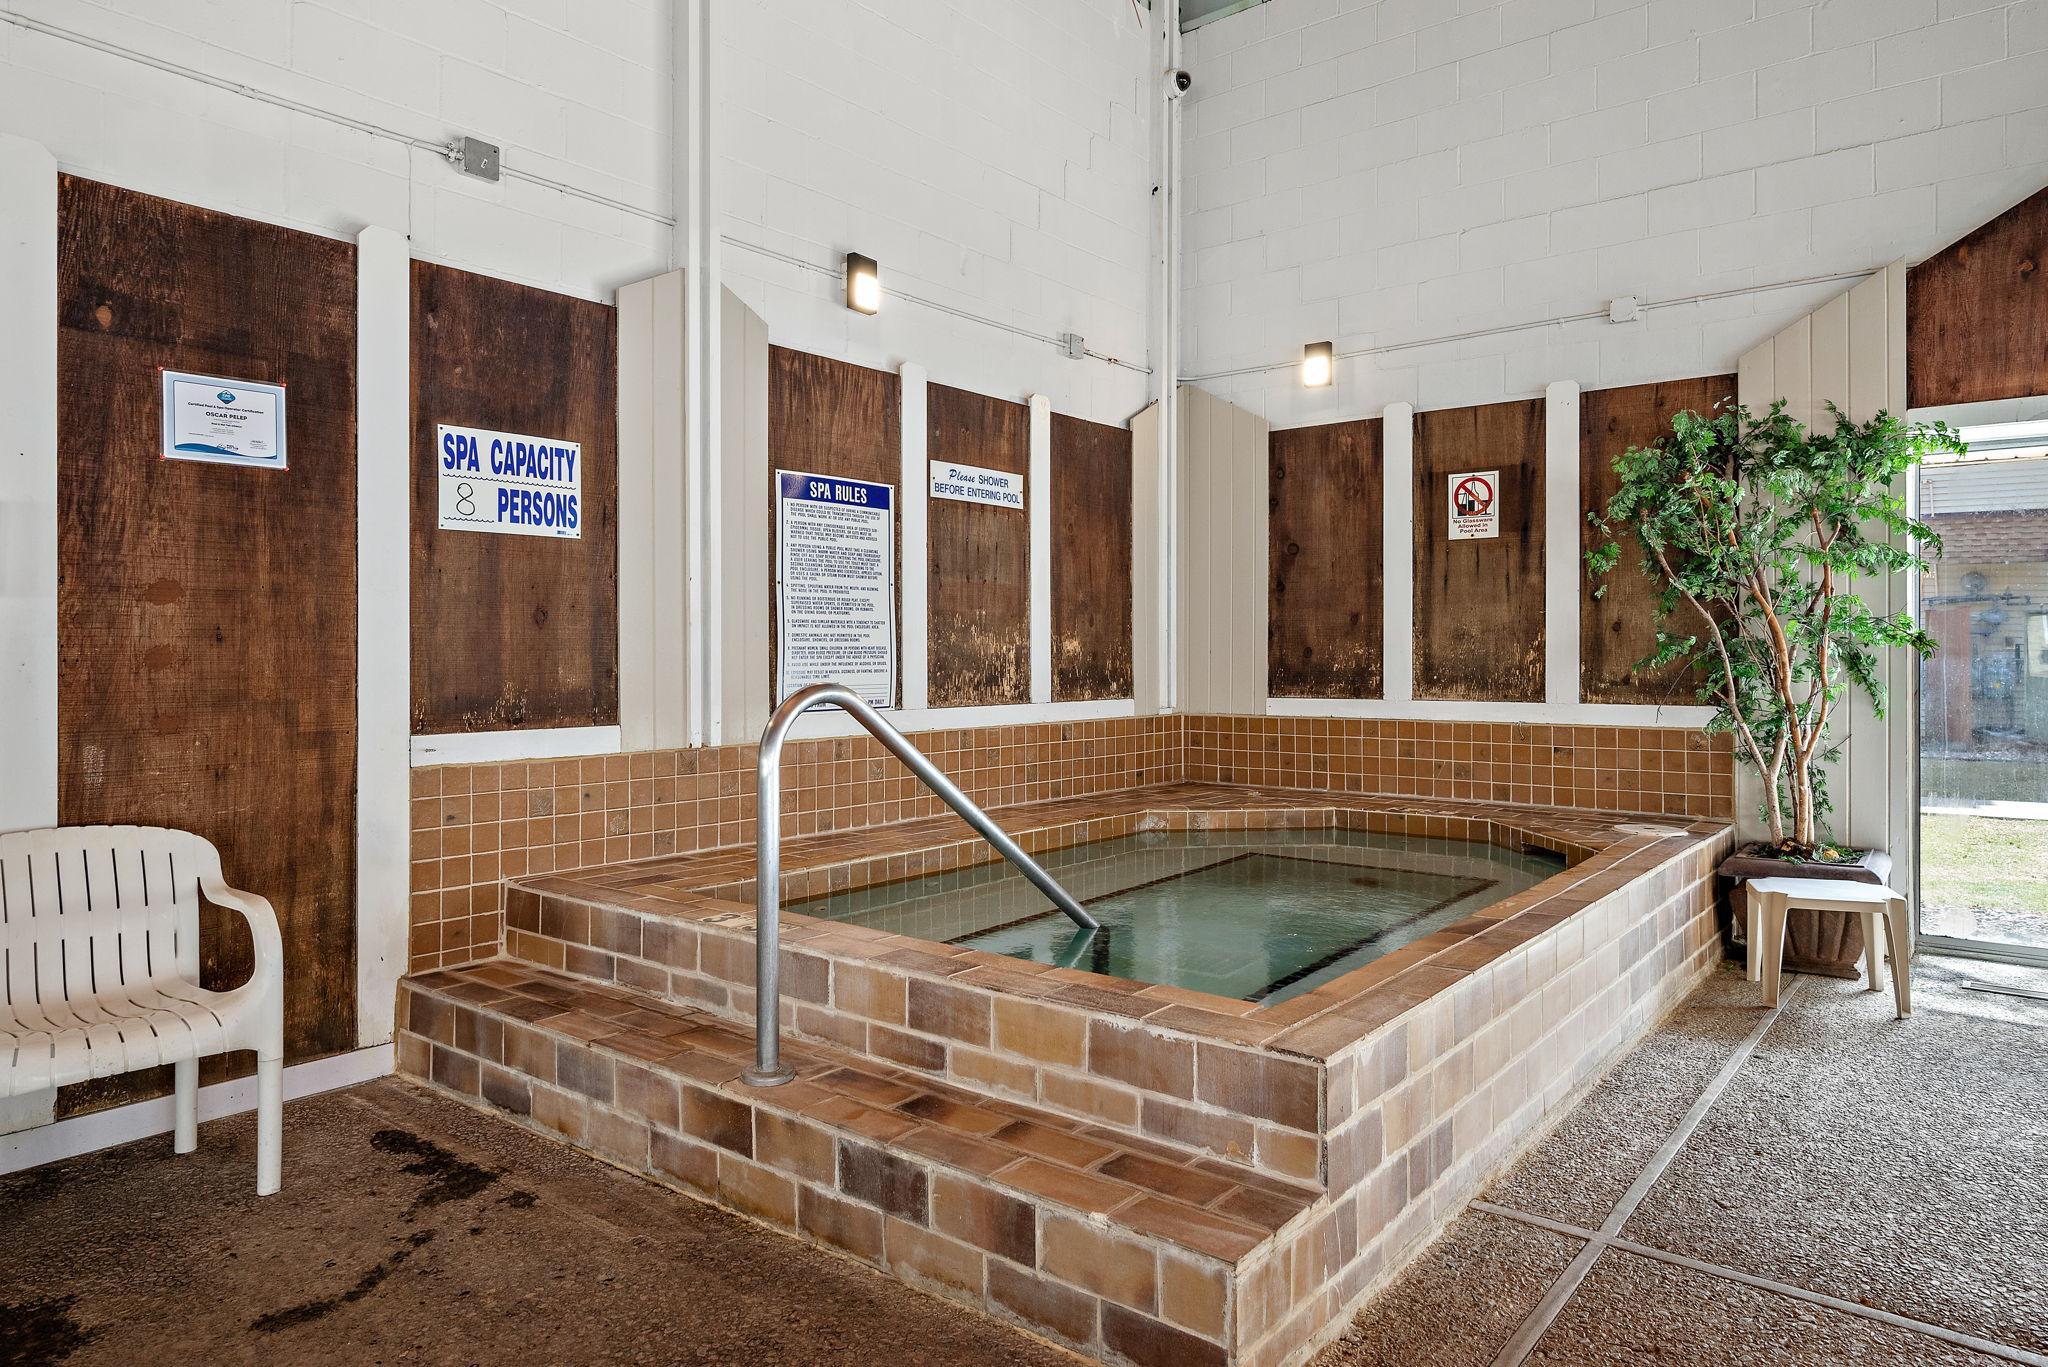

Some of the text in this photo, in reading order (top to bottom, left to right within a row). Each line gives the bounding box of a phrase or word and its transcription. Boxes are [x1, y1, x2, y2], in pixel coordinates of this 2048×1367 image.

[205, 411, 228, 419] OSCAR
[443, 433, 576, 482] SPA CAPACITY
[948, 468, 1009, 488] Please SHOWER
[810, 481, 867, 504] SPA RULES
[934, 482, 1021, 504] BEFORE ENTERING POOL
[456, 482, 578, 529] 8 PERSONS
